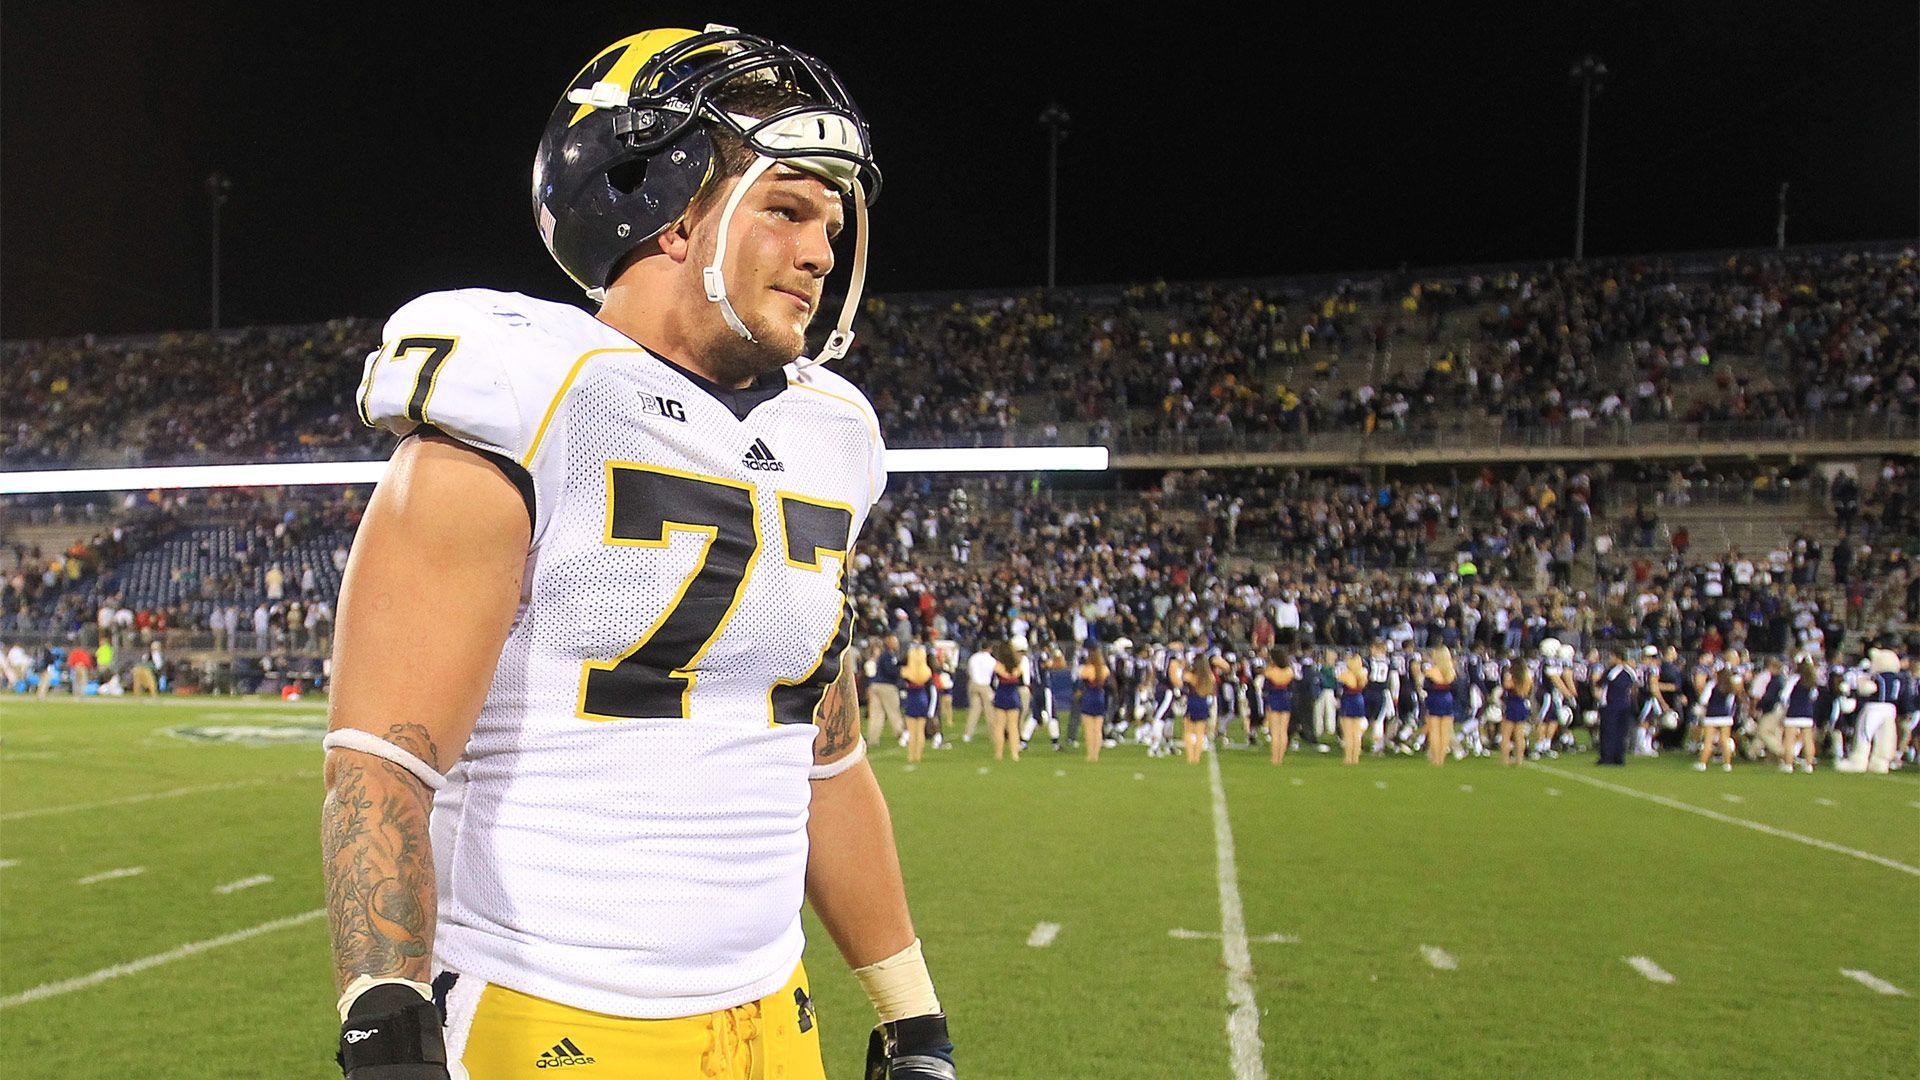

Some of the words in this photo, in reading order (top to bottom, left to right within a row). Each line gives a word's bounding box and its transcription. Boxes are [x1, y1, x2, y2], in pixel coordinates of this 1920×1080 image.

[741, 459, 785, 472] adidas
[576, 459, 856, 728] 77
[535, 1055, 596, 1069] adidas
